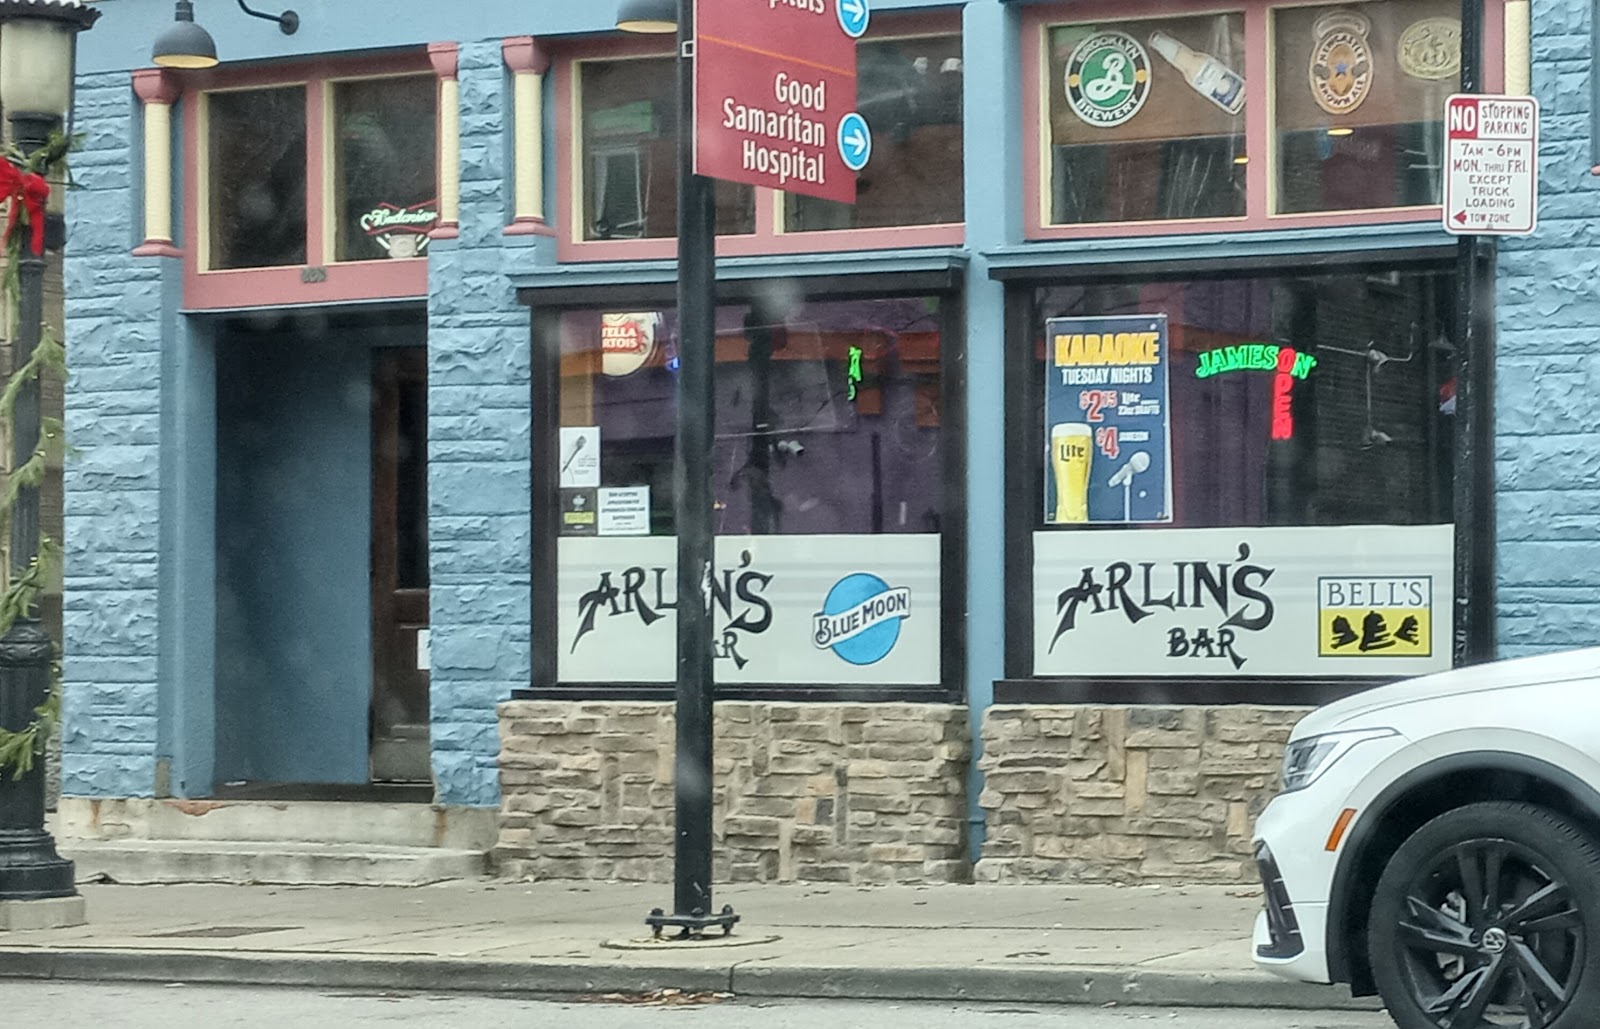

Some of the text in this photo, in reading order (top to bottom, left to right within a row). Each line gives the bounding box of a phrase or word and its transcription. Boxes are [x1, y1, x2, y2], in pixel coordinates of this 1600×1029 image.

[1076, 36, 1140, 63] BROOKLYN
[775, 72, 825, 111] Good
[1075, 94, 1138, 121] BREWERY
[1450, 105, 1476, 132] NO
[1481, 103, 1530, 120] STOPPING
[723, 98, 825, 147] Samaritan
[1484, 121, 1527, 134] PARKING
[743, 139, 825, 184] Hospital
[1461, 143, 1483, 156] 7AM
[1496, 144, 1521, 156] 6PM
[1453, 159, 1528, 173] MON. THRU FRI.
[1469, 175, 1513, 184] EXCEPT
[1465, 198, 1515, 208] LOADING
[1472, 187, 1510, 196] TRUCK
[1470, 213, 1510, 223] TOW ZONE
[1055, 332, 1160, 367] KARAOKE
[1195, 345, 1317, 379] JAMESON
[1061, 367, 1152, 385] TUESDAY NIGHTS
[1272, 347, 1296, 439] OPEN
[1060, 444, 1085, 461] Lite
[1096, 426, 1119, 460] $4
[570, 549, 774, 655] ARLN'S
[1047, 542, 1275, 655] ARLIN'S
[1327, 582, 1423, 606] BELL'S
[814, 592, 907, 646] BLUE MOON
[1165, 627, 1247, 670] BAR
